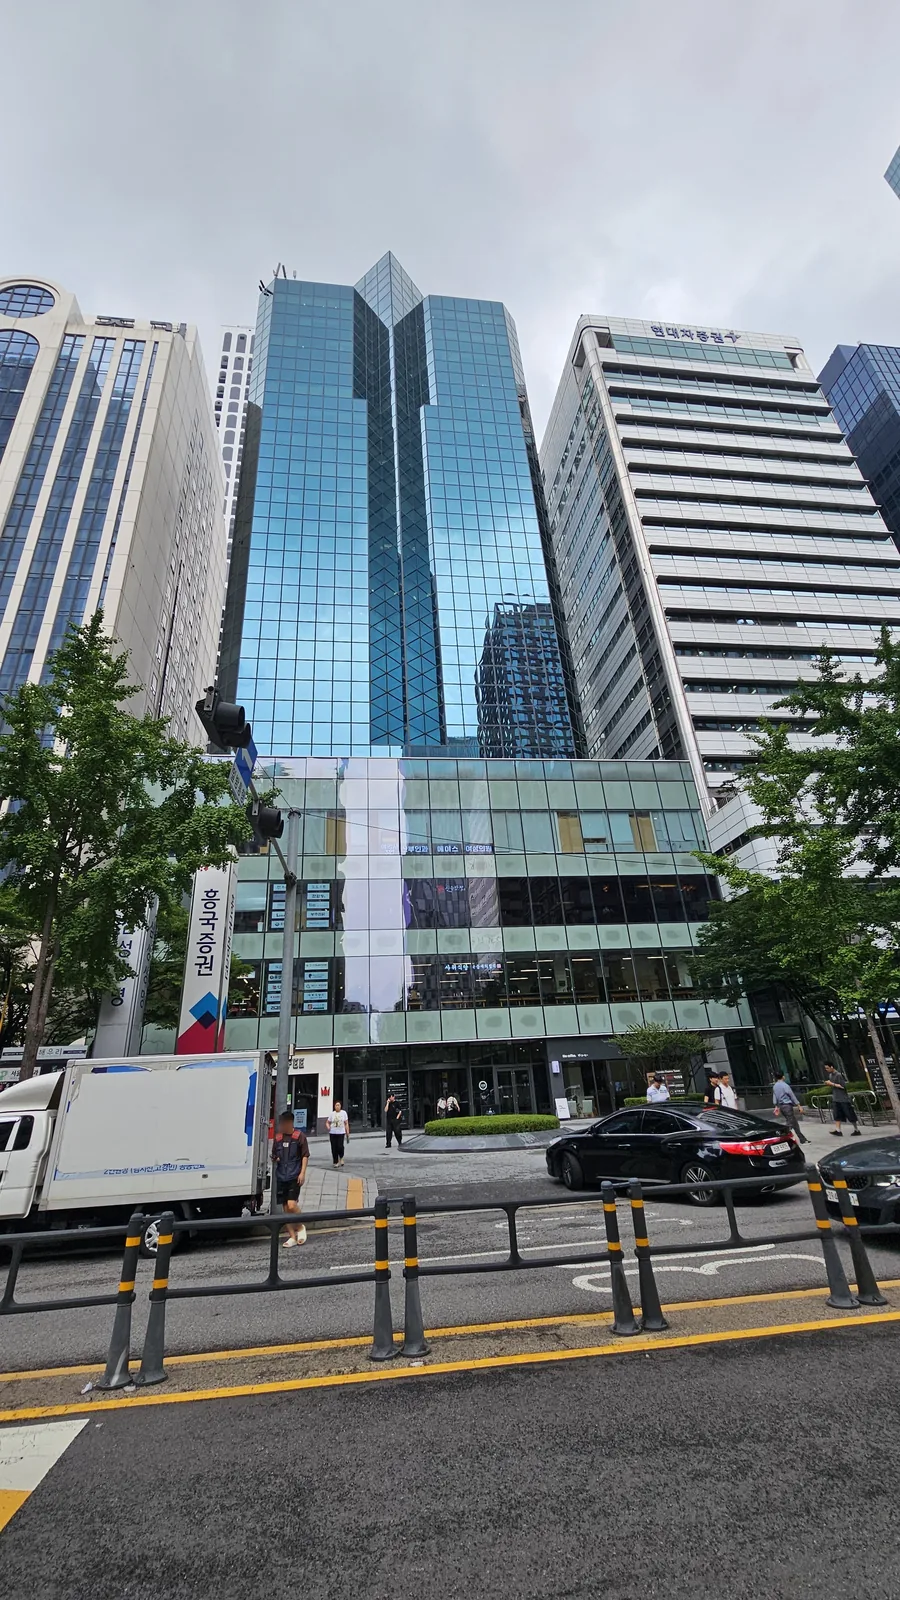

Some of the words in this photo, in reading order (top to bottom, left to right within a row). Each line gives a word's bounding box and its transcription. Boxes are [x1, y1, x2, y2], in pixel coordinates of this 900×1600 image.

[650, 325, 724, 344] 현대차증권
[437, 845, 459, 853] 에이스
[194, 888, 220, 977] 흥국증권
